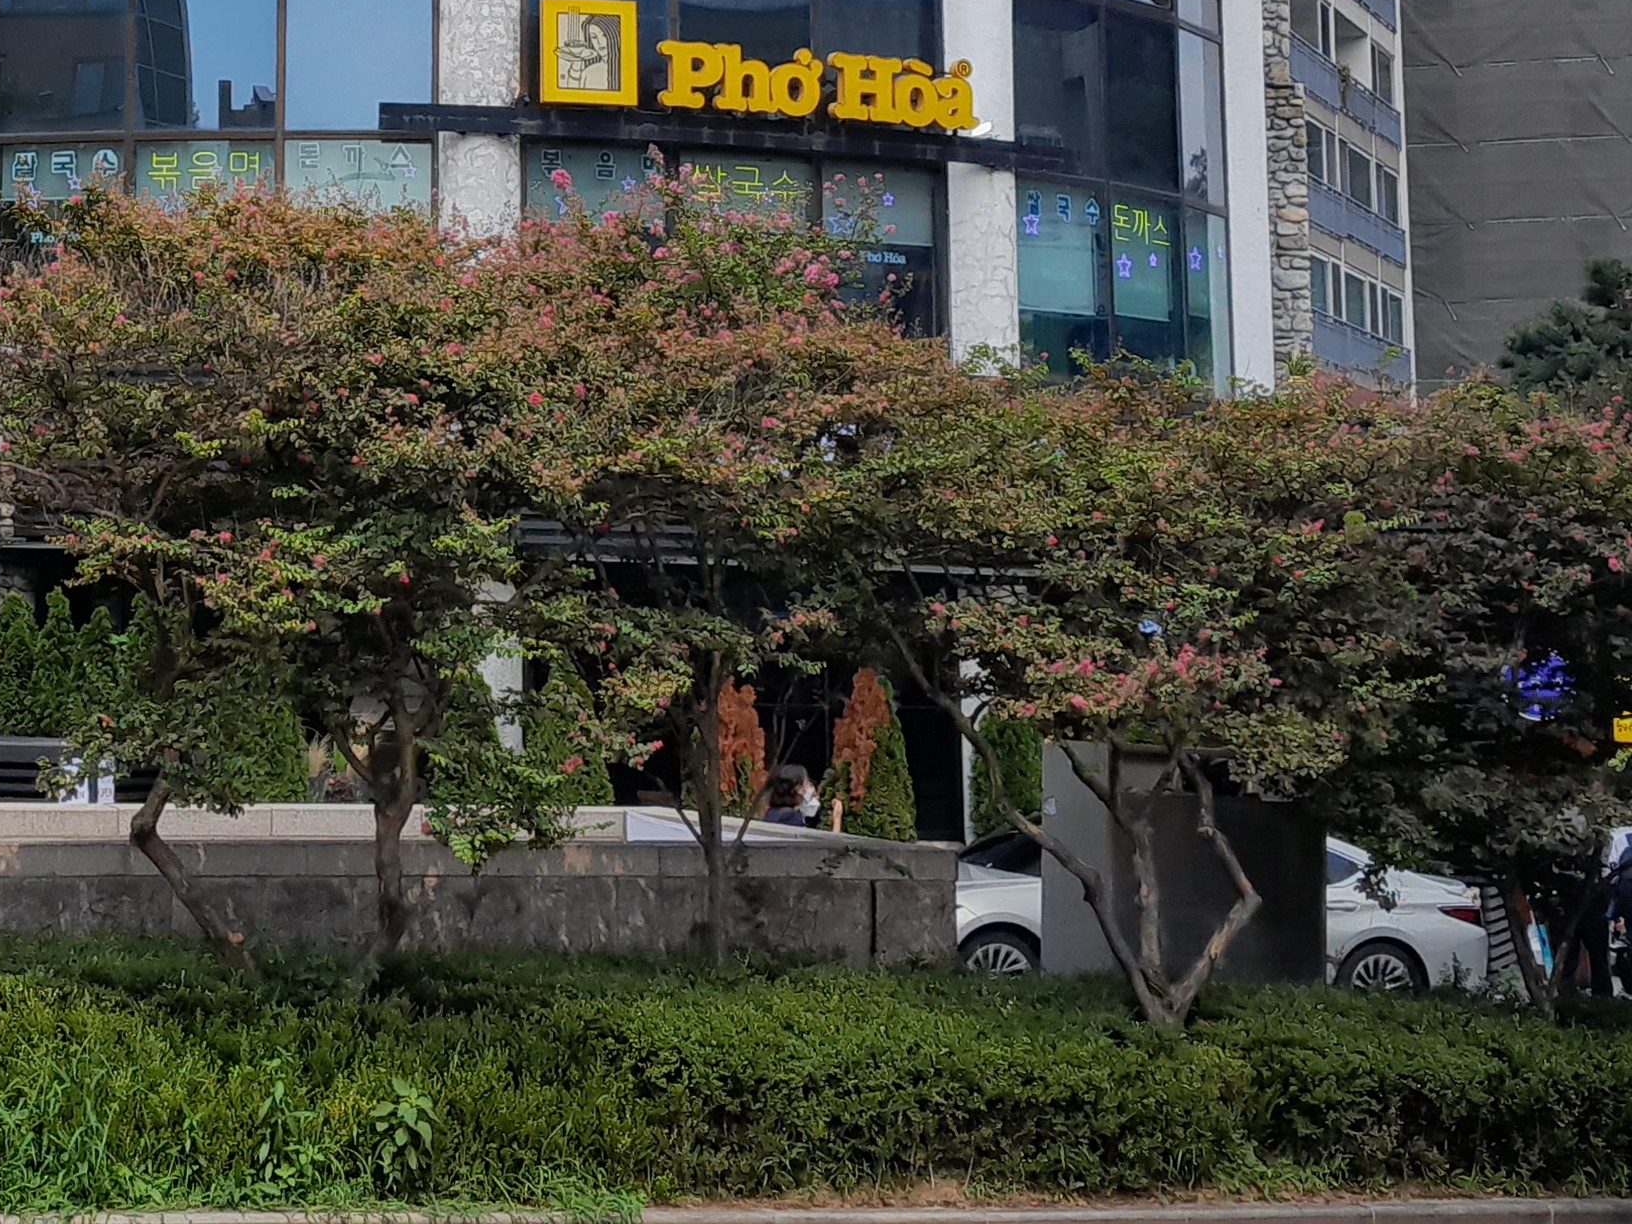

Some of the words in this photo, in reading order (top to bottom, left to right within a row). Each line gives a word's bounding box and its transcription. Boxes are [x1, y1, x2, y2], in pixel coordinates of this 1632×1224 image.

[12, 149, 118, 181] 쌀국수
[1027, 189, 1100, 225] 쌀국수
[1112, 203, 1171, 246] 돈까스
